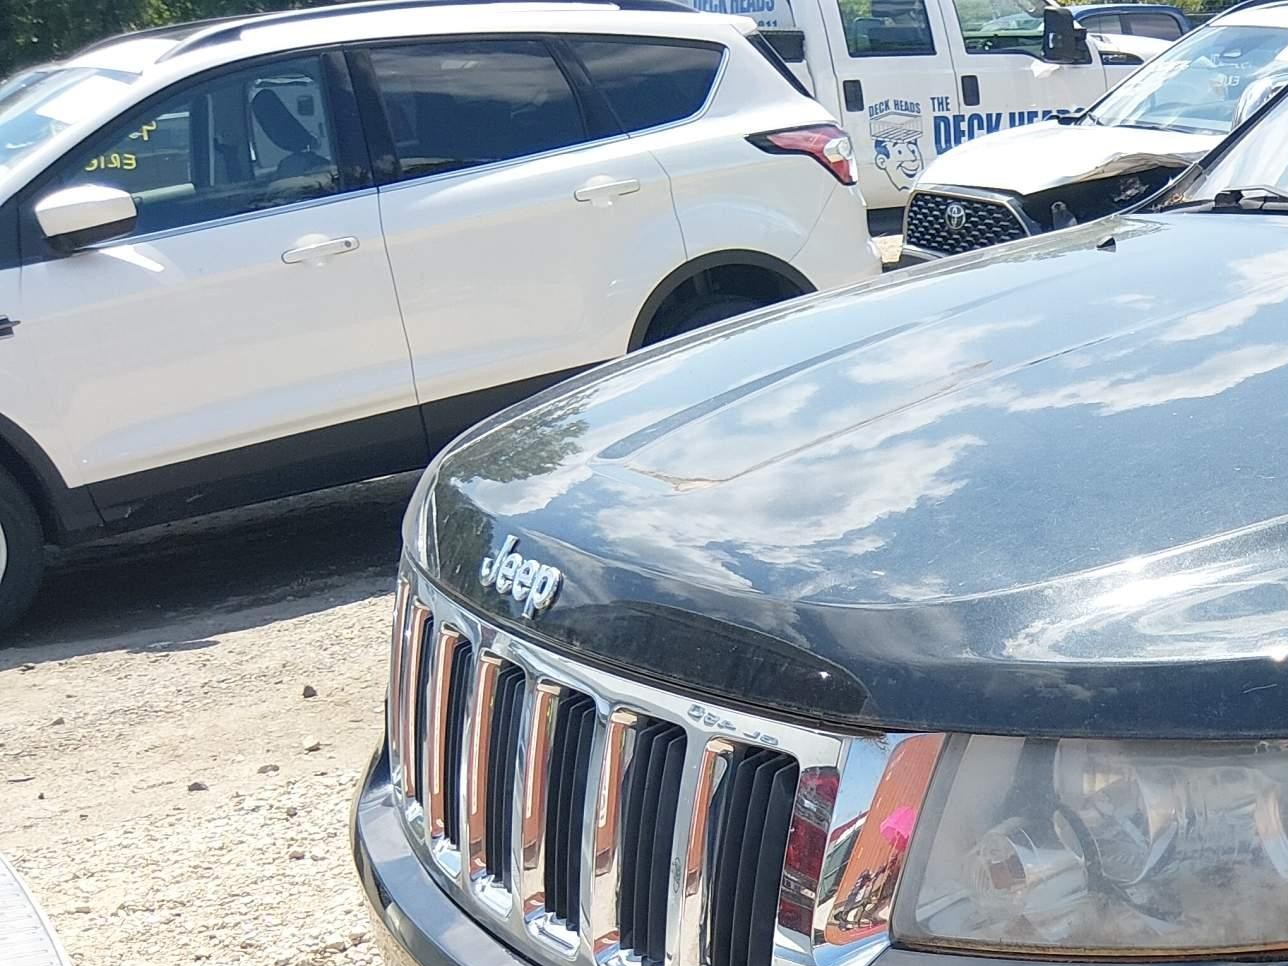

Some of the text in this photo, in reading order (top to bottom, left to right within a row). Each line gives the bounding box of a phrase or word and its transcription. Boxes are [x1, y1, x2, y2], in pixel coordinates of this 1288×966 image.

[868, 99, 921, 117] DECK HEADS
[930, 96, 951, 112] THE
[479, 534, 562, 620] Jeep
